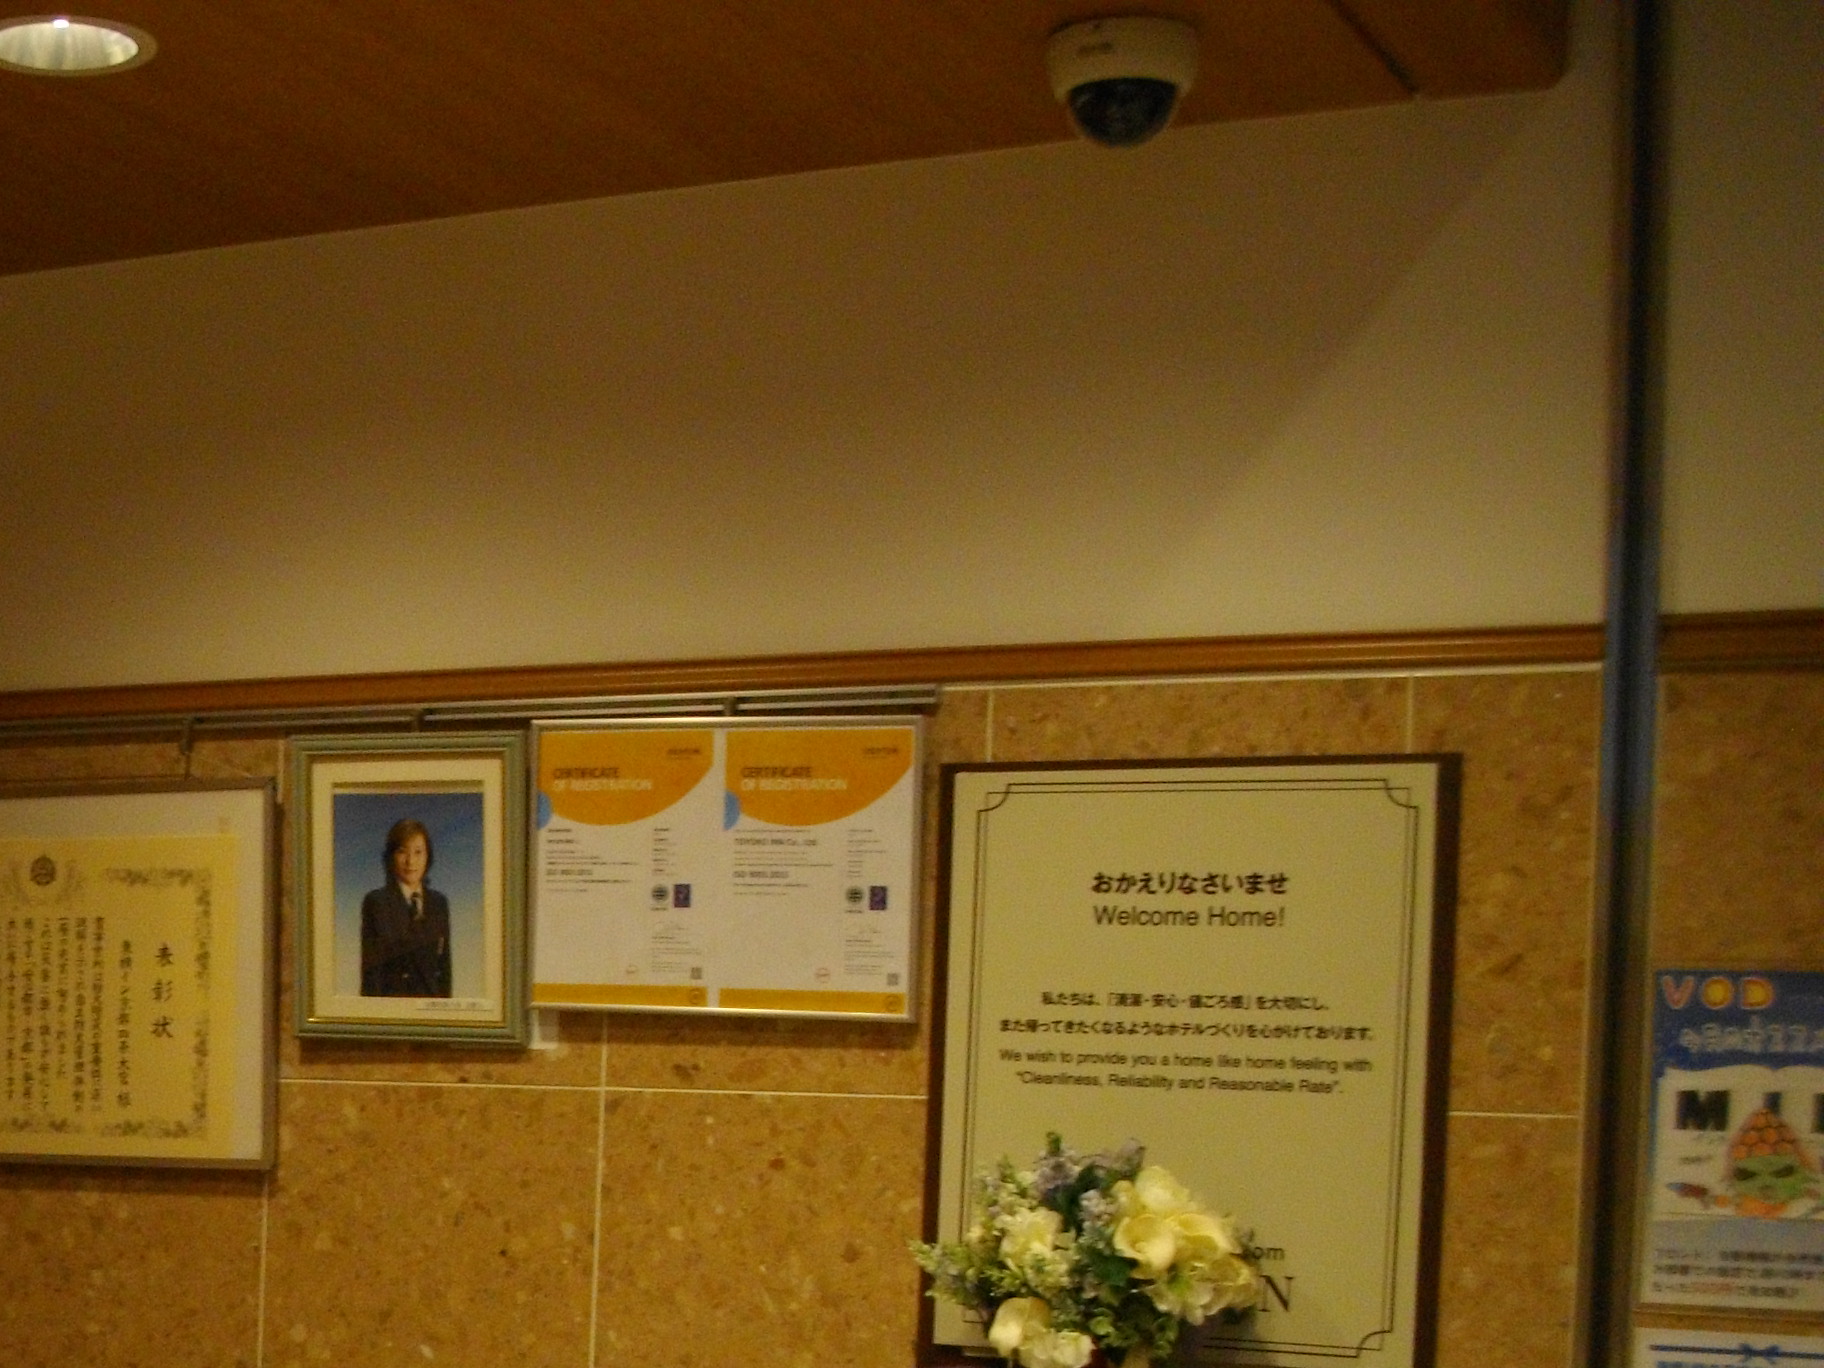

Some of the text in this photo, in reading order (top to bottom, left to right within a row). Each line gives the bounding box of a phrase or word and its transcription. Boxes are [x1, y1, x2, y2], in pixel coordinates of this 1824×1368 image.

[1091, 871, 1289, 896] おかえりなさいませ
[1093, 905, 1286, 928] Welcome Home!
[151, 942, 174, 1040] 表彰状
[1662, 975, 1775, 1010] VOD
[1000, 1049, 1373, 1073] We wish to provide you a home like home feeling with
[1108, 1074, 1173, 1091] Reliability
[1178, 1076, 1206, 1089] and
[1209, 1076, 1295, 1093] Reasonable
